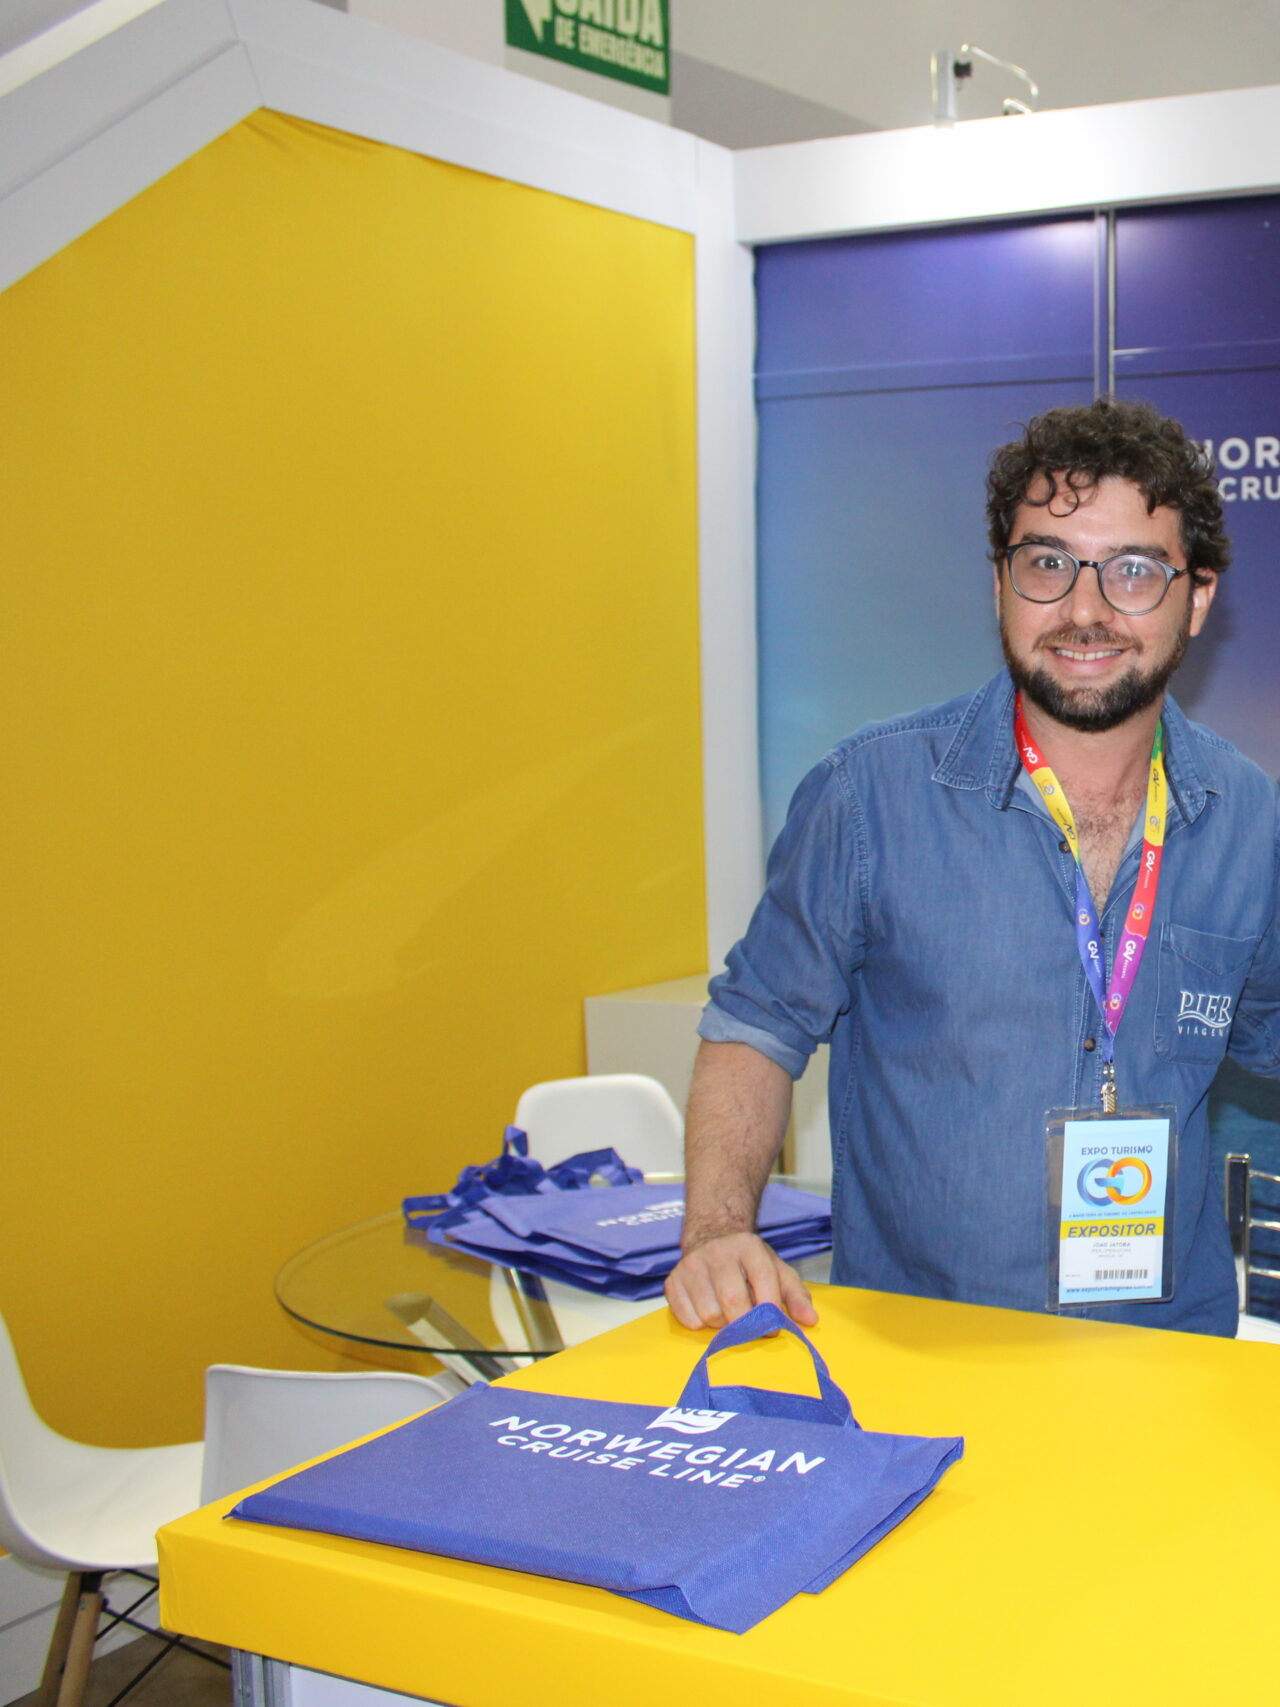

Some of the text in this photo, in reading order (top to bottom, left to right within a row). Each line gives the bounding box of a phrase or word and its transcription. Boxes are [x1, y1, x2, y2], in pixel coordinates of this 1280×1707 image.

[1180, 990, 1231, 1022] PIER
[1178, 1026, 1230, 1037] VIAGEN
[1081, 1145, 1153, 1156] EXPO TURISMO
[1067, 1223, 1156, 1238] EXPOSITOR
[488, 1415, 826, 1474] NORWEGIAN
[497, 1435, 645, 1471] CRUISE
